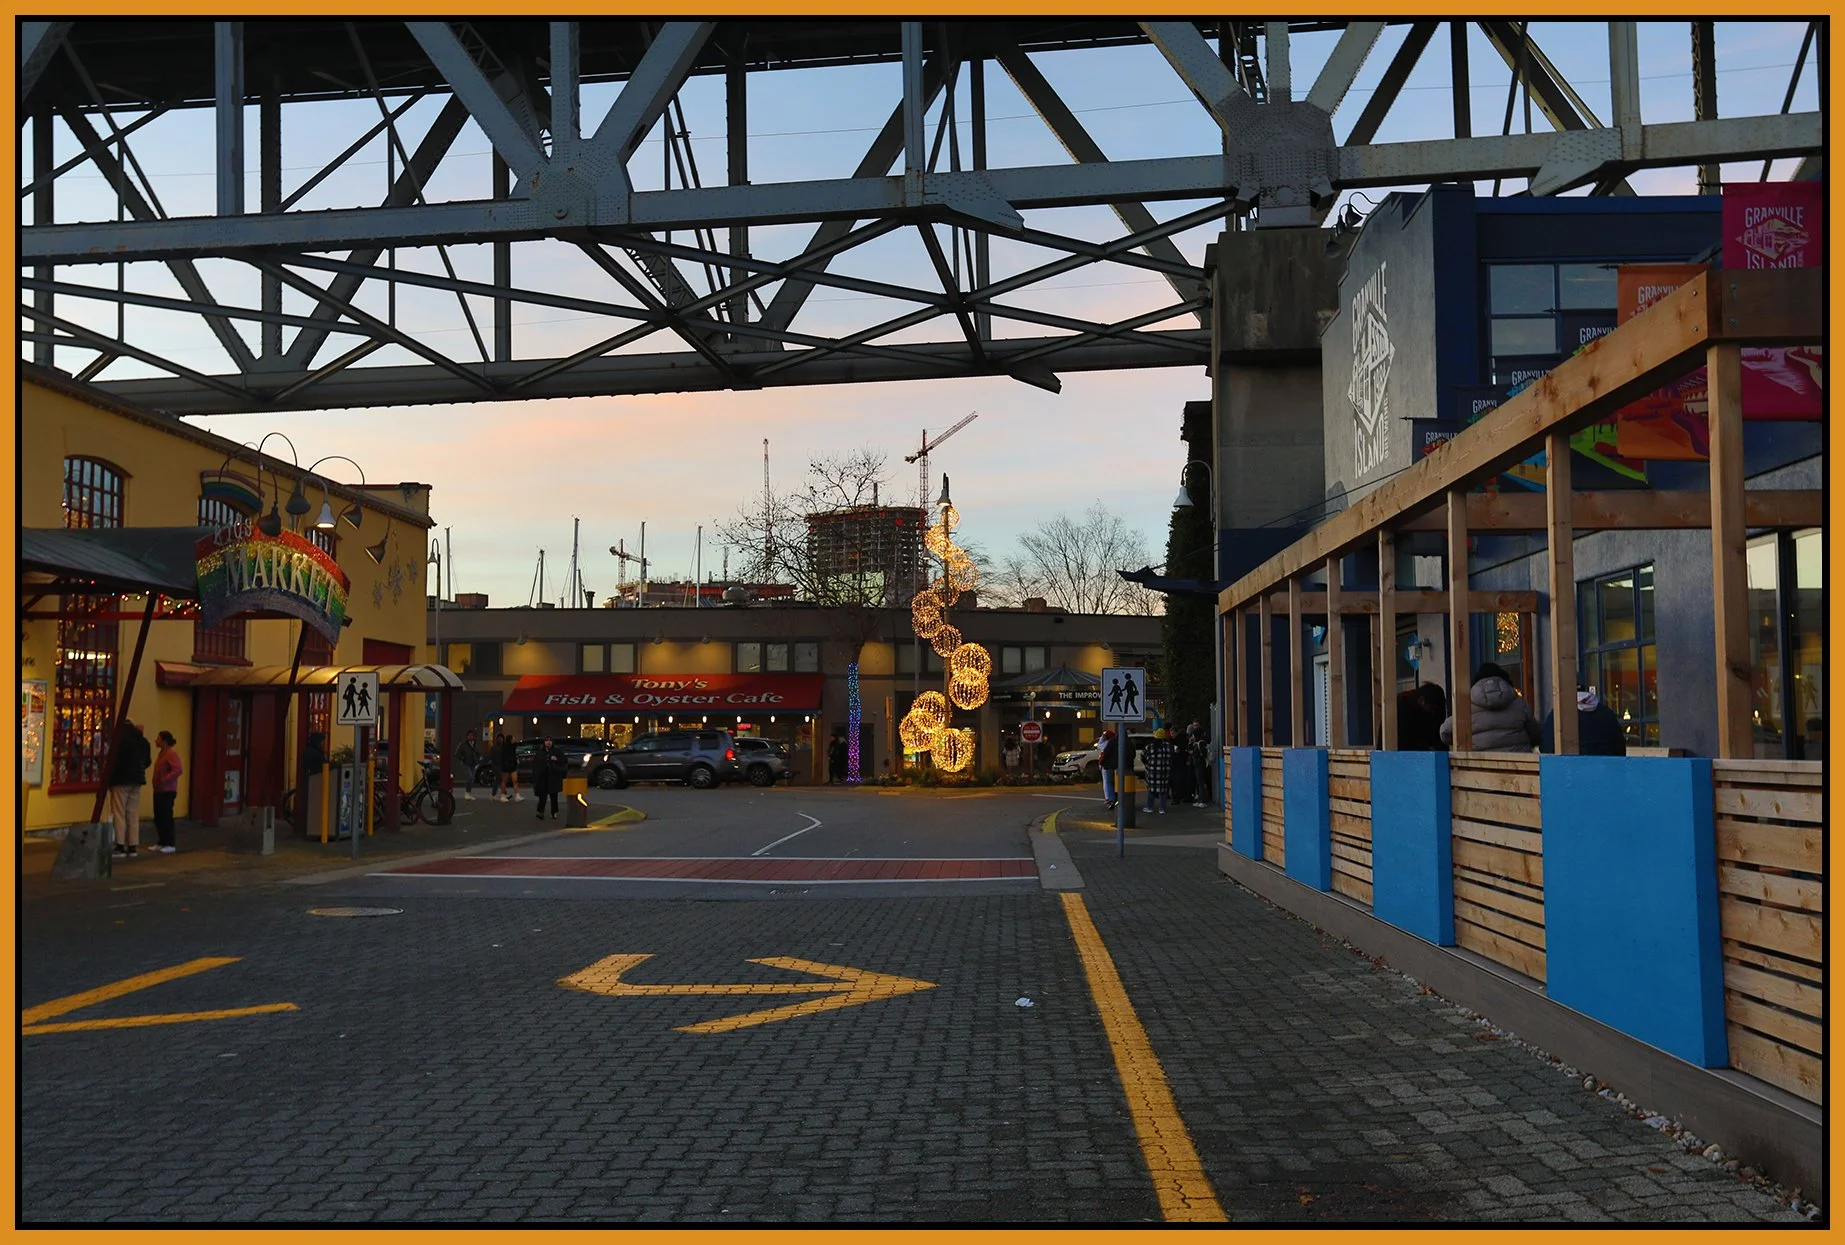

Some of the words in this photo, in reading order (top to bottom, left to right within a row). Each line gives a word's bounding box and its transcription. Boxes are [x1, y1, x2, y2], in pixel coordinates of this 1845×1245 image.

[1745, 206, 1804, 229] GRANVILLE
[1352, 260, 1388, 354] GRANVILLE
[1353, 412, 1385, 479] ISLAND
[224, 547, 336, 618] MARKET
[631, 679, 708, 691] Tony's
[1058, 691, 1073, 699] THE
[544, 694, 597, 705] Fish
[604, 694, 625, 705] &
[632, 693, 720, 706] Oyster
[726, 693, 785, 704] Cafe
